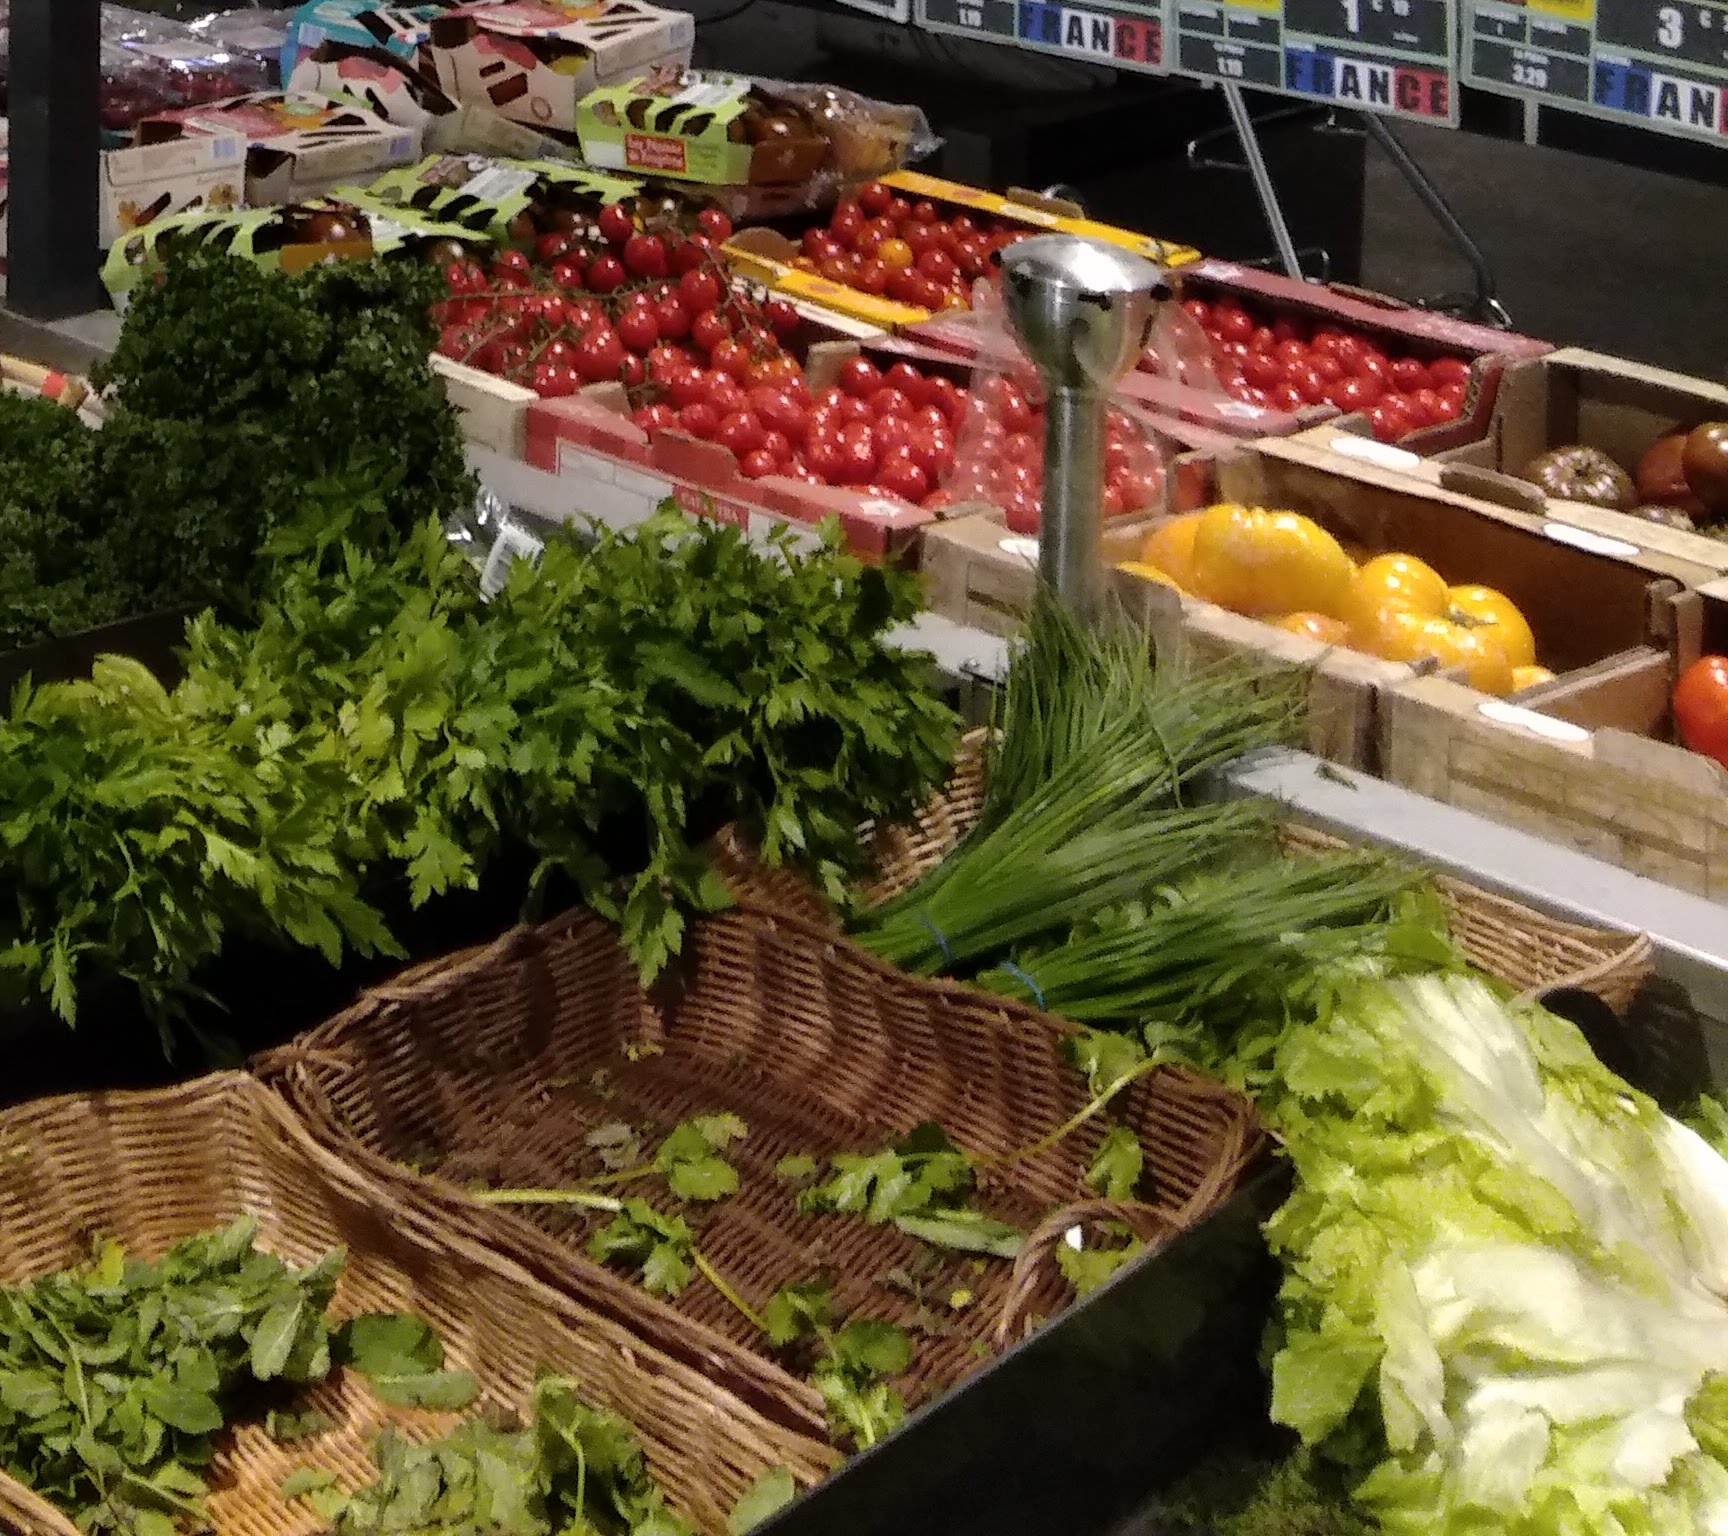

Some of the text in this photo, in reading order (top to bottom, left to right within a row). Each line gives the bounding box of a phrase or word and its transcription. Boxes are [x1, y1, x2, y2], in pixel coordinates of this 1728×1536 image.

[1656, 6, 1685, 50] 3
[1286, 50, 1448, 118] FRANCE
[1596, 65, 1718, 131] FRAN
